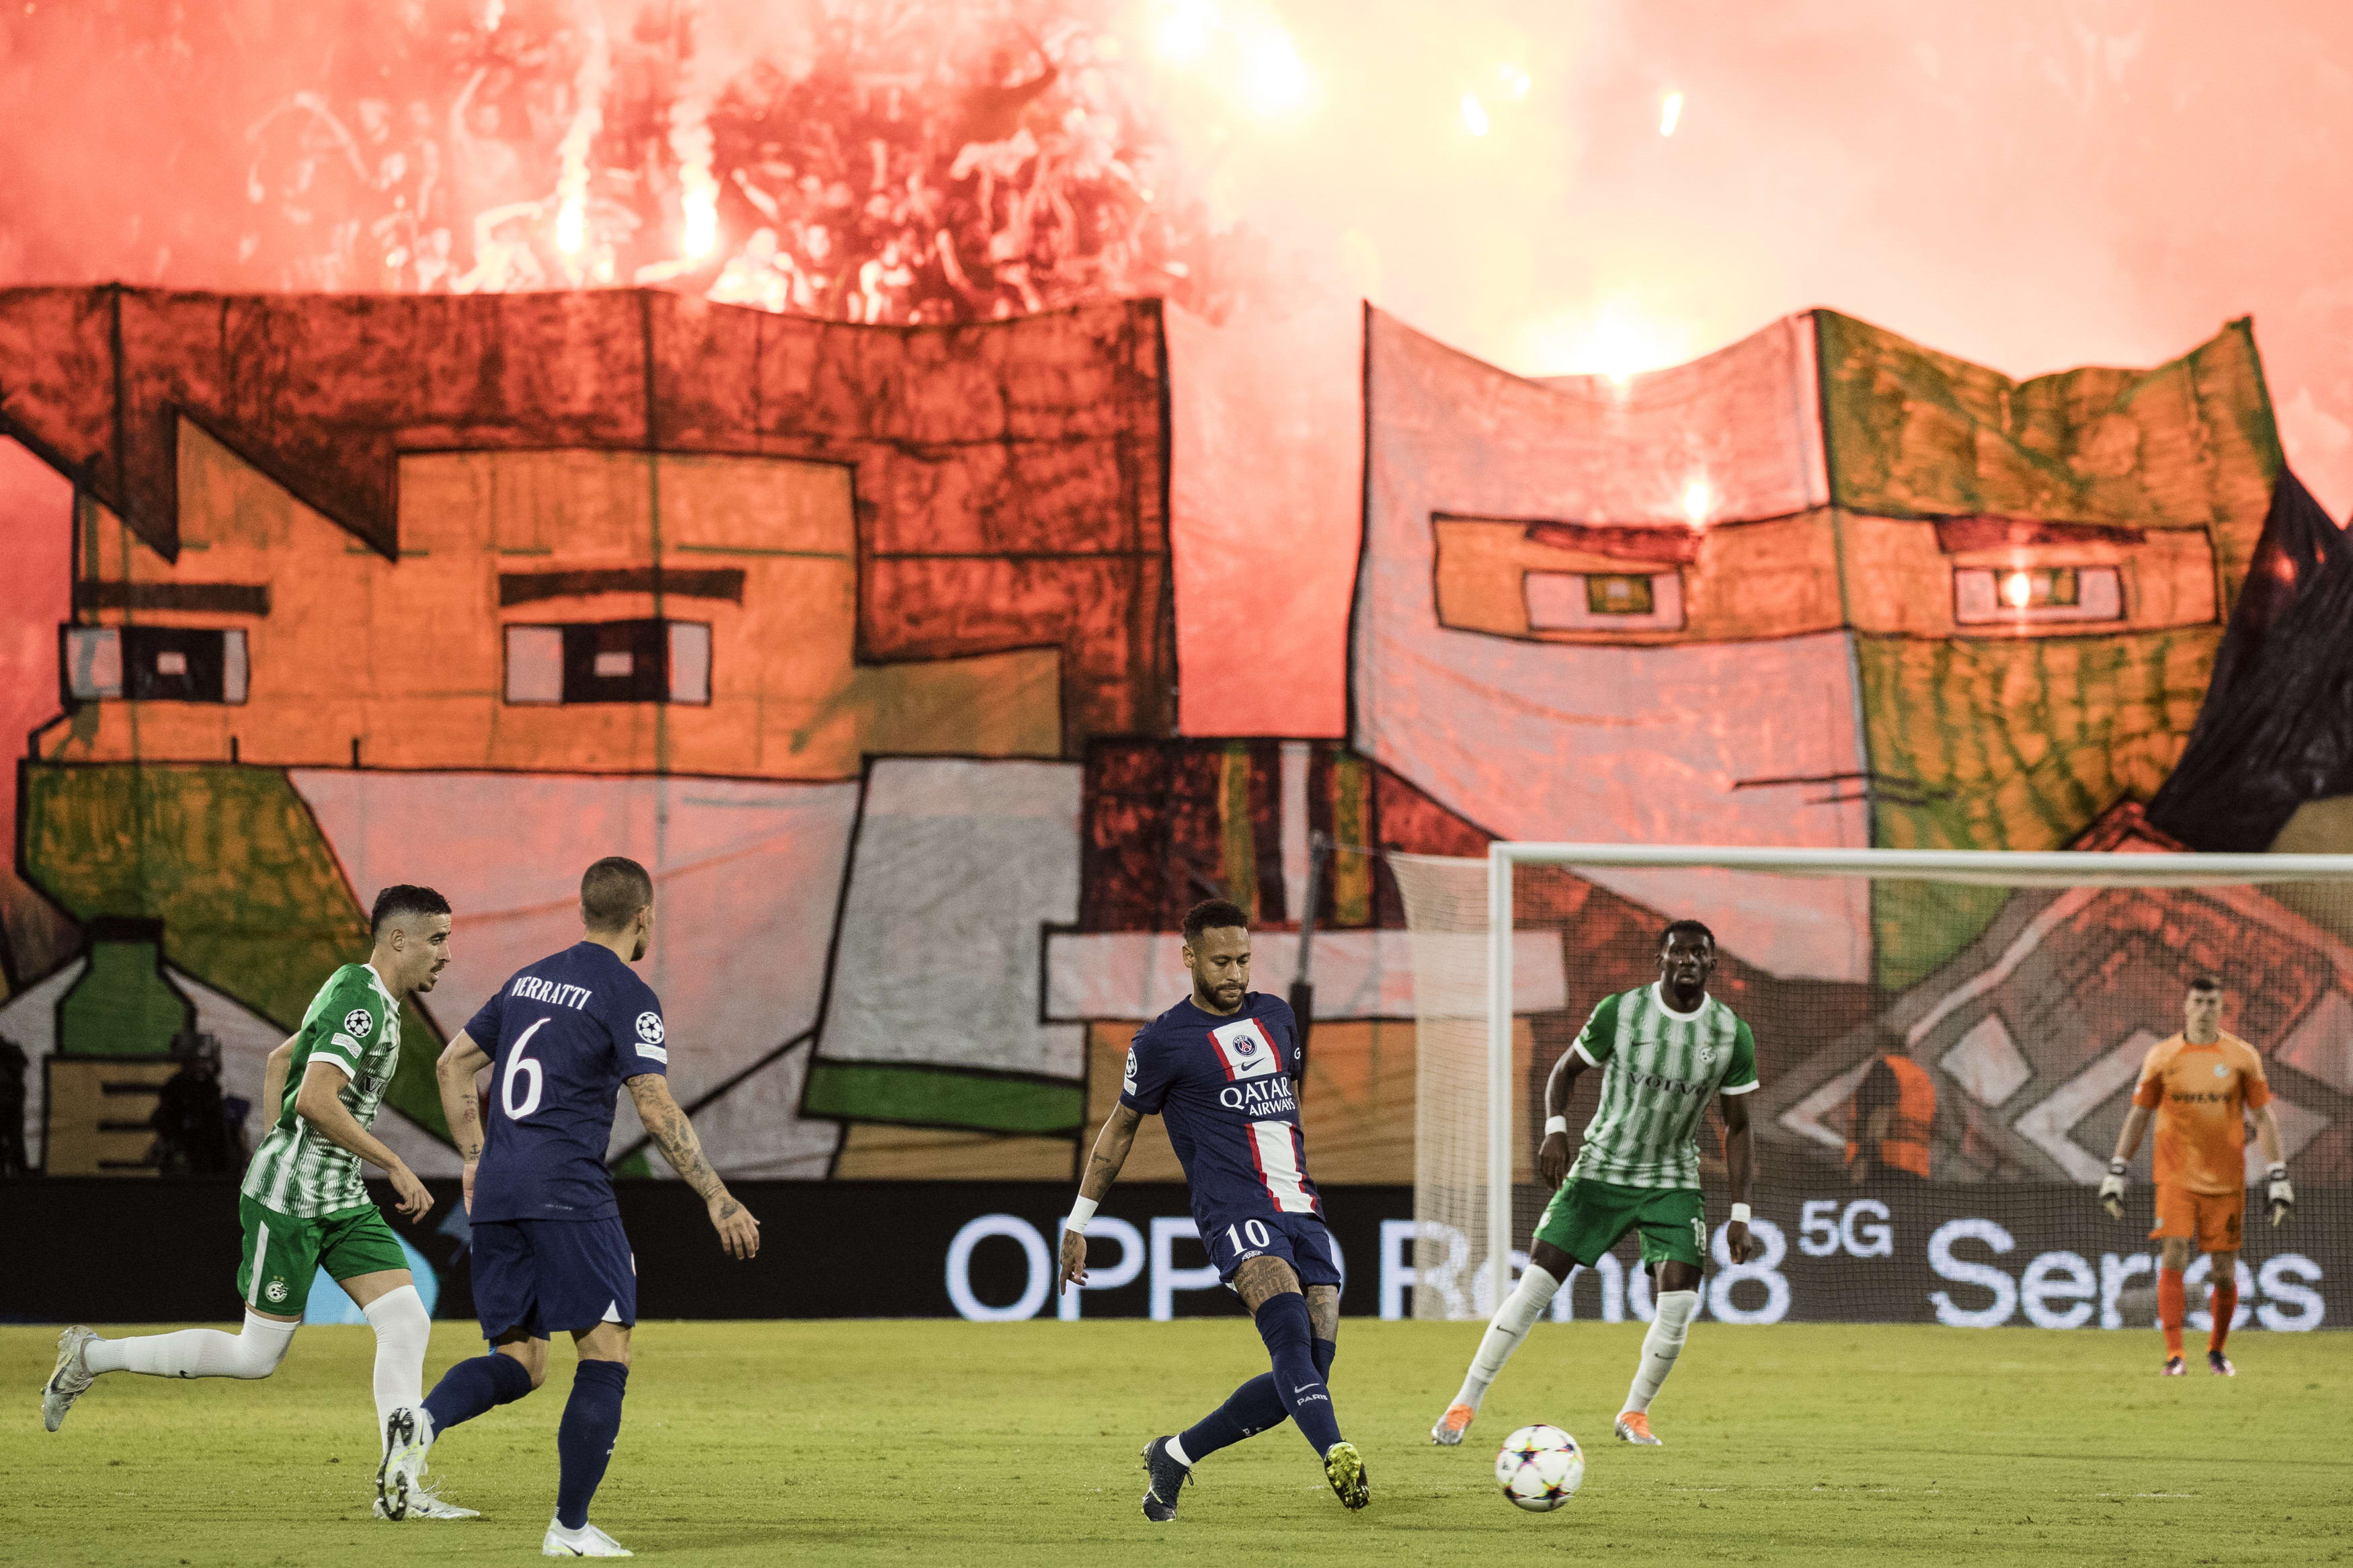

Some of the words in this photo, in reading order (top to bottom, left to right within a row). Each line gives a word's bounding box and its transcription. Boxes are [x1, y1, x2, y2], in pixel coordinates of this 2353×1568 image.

[511, 976, 592, 1010] VERRATTI
[502, 1018, 551, 1120] 6
[1220, 1076, 1292, 1110] QATAR
[1249, 1097, 1295, 1116] AIRWAYS
[1226, 1219, 1270, 1257] 10
[945, 1213, 1345, 1322] OPP
[1800, 1199, 1893, 1257] 5G
[1928, 1217, 2326, 1332] Seres
[1297, 1394, 1328, 1406] PARIS
